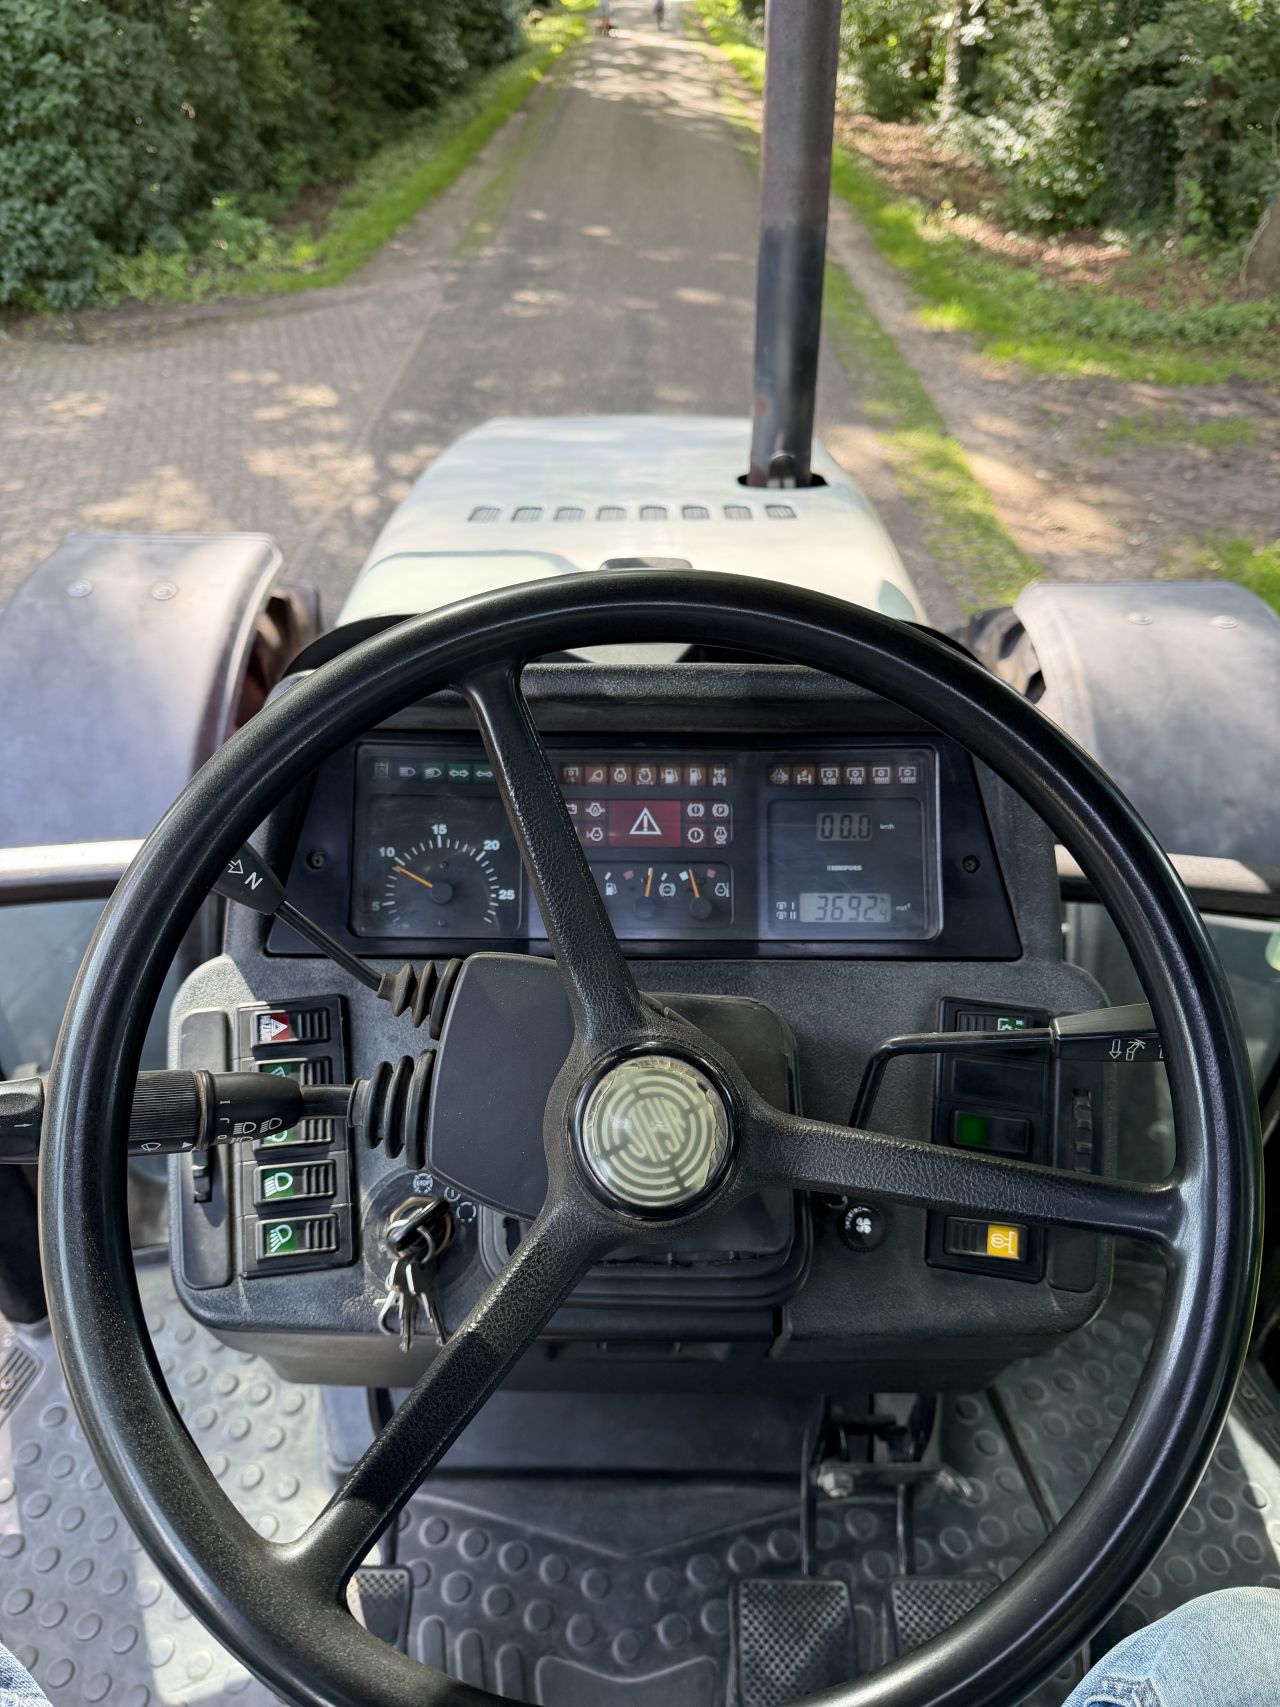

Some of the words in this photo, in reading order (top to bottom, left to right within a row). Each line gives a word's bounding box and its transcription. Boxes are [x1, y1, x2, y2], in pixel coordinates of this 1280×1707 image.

[432, 824, 447, 835] 15
[821, 814, 871, 839] 00.0
[483, 840, 500, 851] 20
[379, 847, 396, 858] 10
[244, 871, 264, 891] N
[498, 889, 515, 901] 25
[371, 901, 380, 912] 5
[623, 1096, 687, 1163] STEYR
